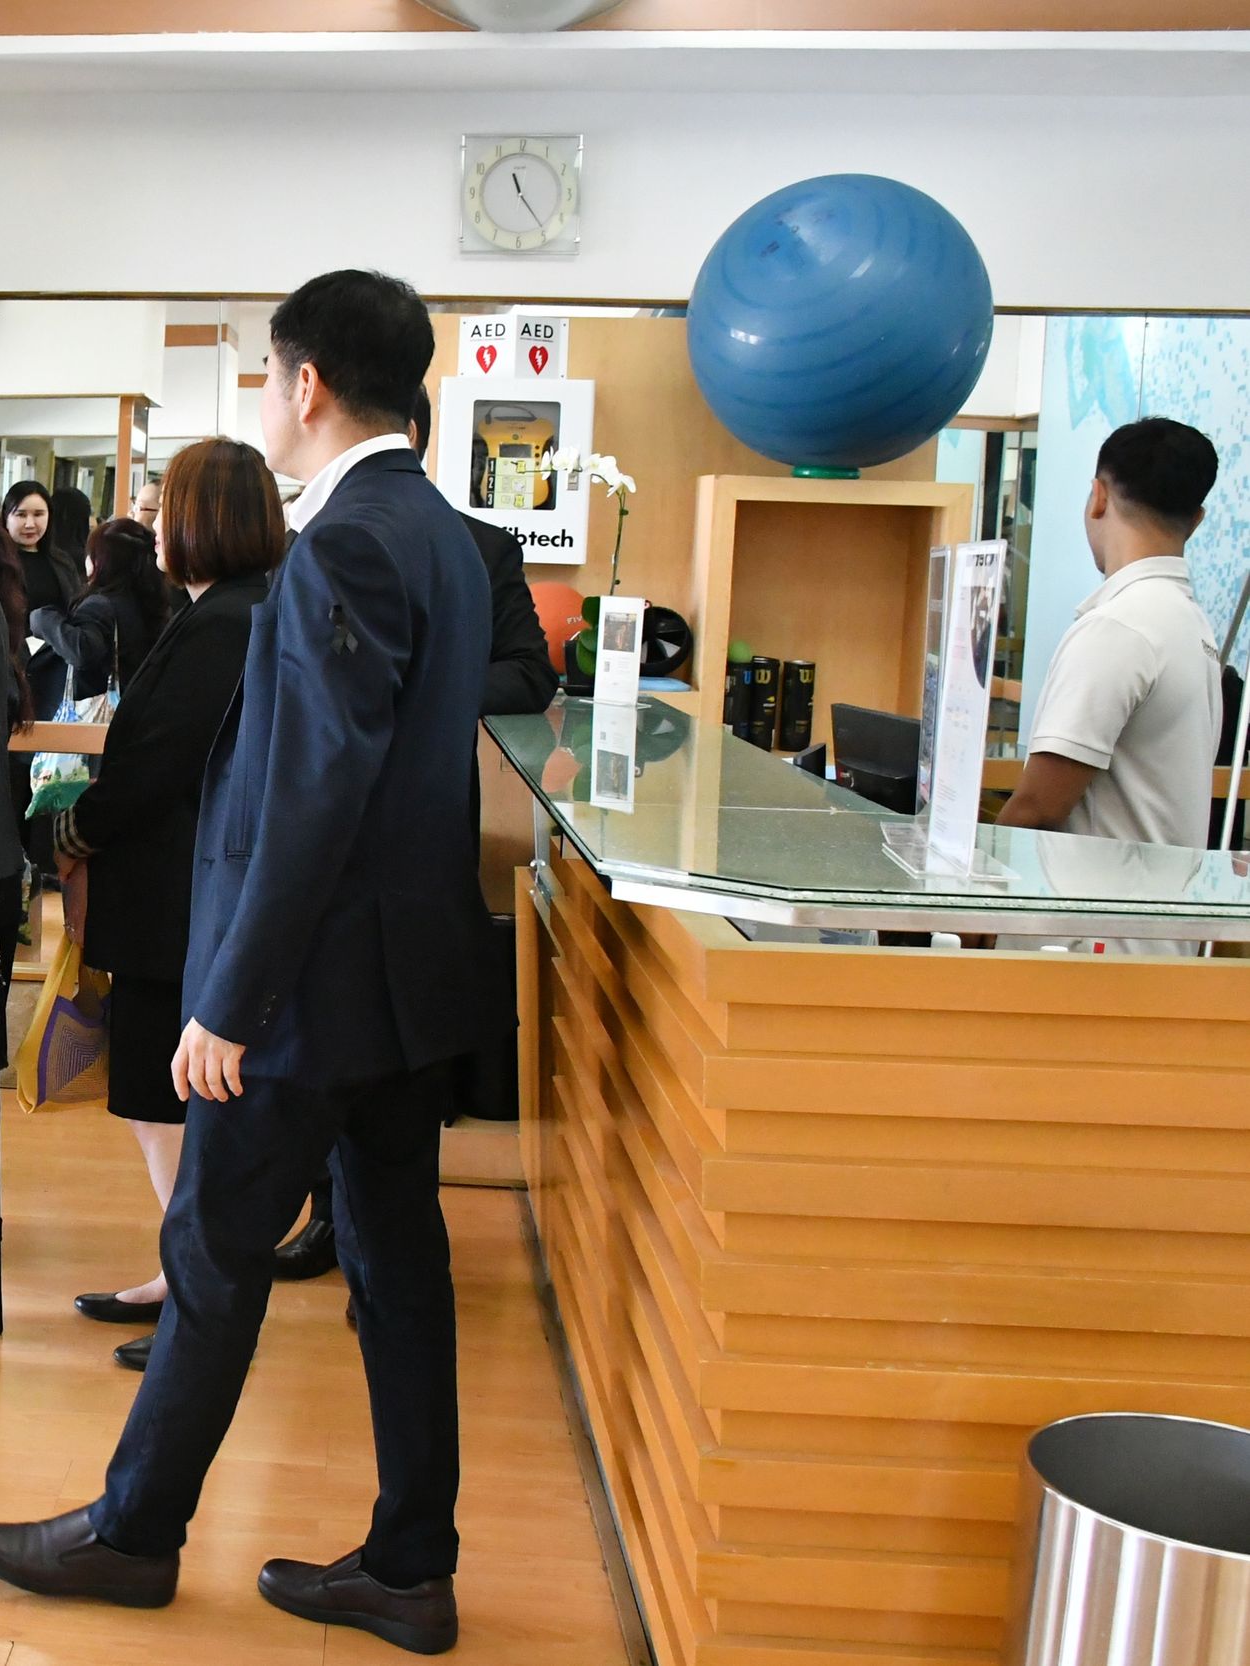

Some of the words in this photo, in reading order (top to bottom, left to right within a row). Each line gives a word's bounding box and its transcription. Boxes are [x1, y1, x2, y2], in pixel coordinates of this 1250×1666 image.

[495, 145, 502, 157] 11
[519, 139, 527, 152] 12
[476, 163, 485, 175] 10
[561, 163, 566, 176] 2
[469, 187, 475, 199] 9
[567, 188, 572, 200] 3
[474, 211, 480, 223] 8
[492, 229, 497, 241] 7
[516, 236, 521, 248] 6
[470, 323, 506, 338] AED
[520, 322, 554, 339] AED
[489, 459, 494, 473] 1
[488, 477, 494, 489] 2
[487, 495, 493, 506] 3
[502, 526, 574, 548] btech
